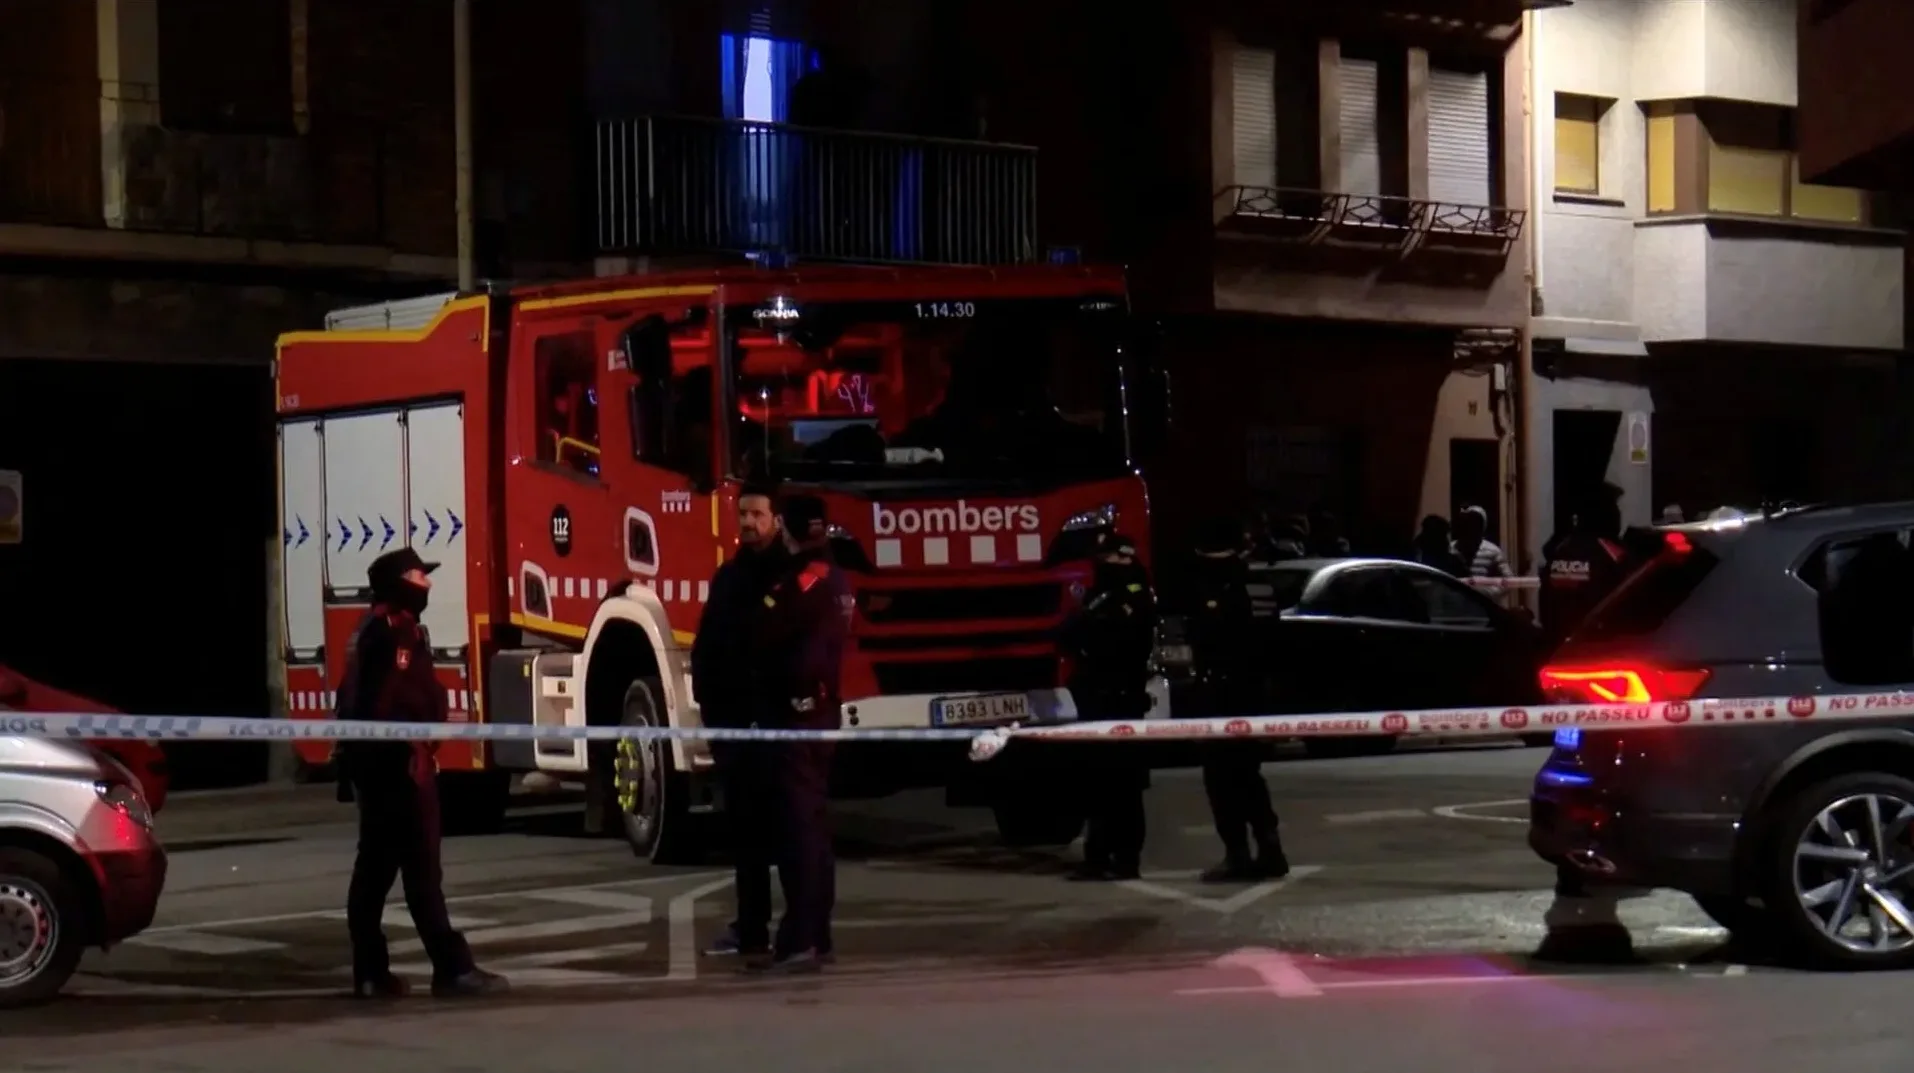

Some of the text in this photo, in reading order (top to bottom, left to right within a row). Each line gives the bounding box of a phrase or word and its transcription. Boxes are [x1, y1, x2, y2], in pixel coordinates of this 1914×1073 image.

[752, 309, 800, 319] SCANIA
[914, 302, 975, 318] 1.14.30
[553, 517, 569, 536] 112
[873, 499, 1040, 535] bombers
[1550, 559, 1590, 573] POLICIA
[945, 697, 1025, 720] 8393 LNH
[1541, 711, 1568, 724] NO
[1574, 707, 1650, 723] PASSEU
[1829, 696, 1859, 711] NO
